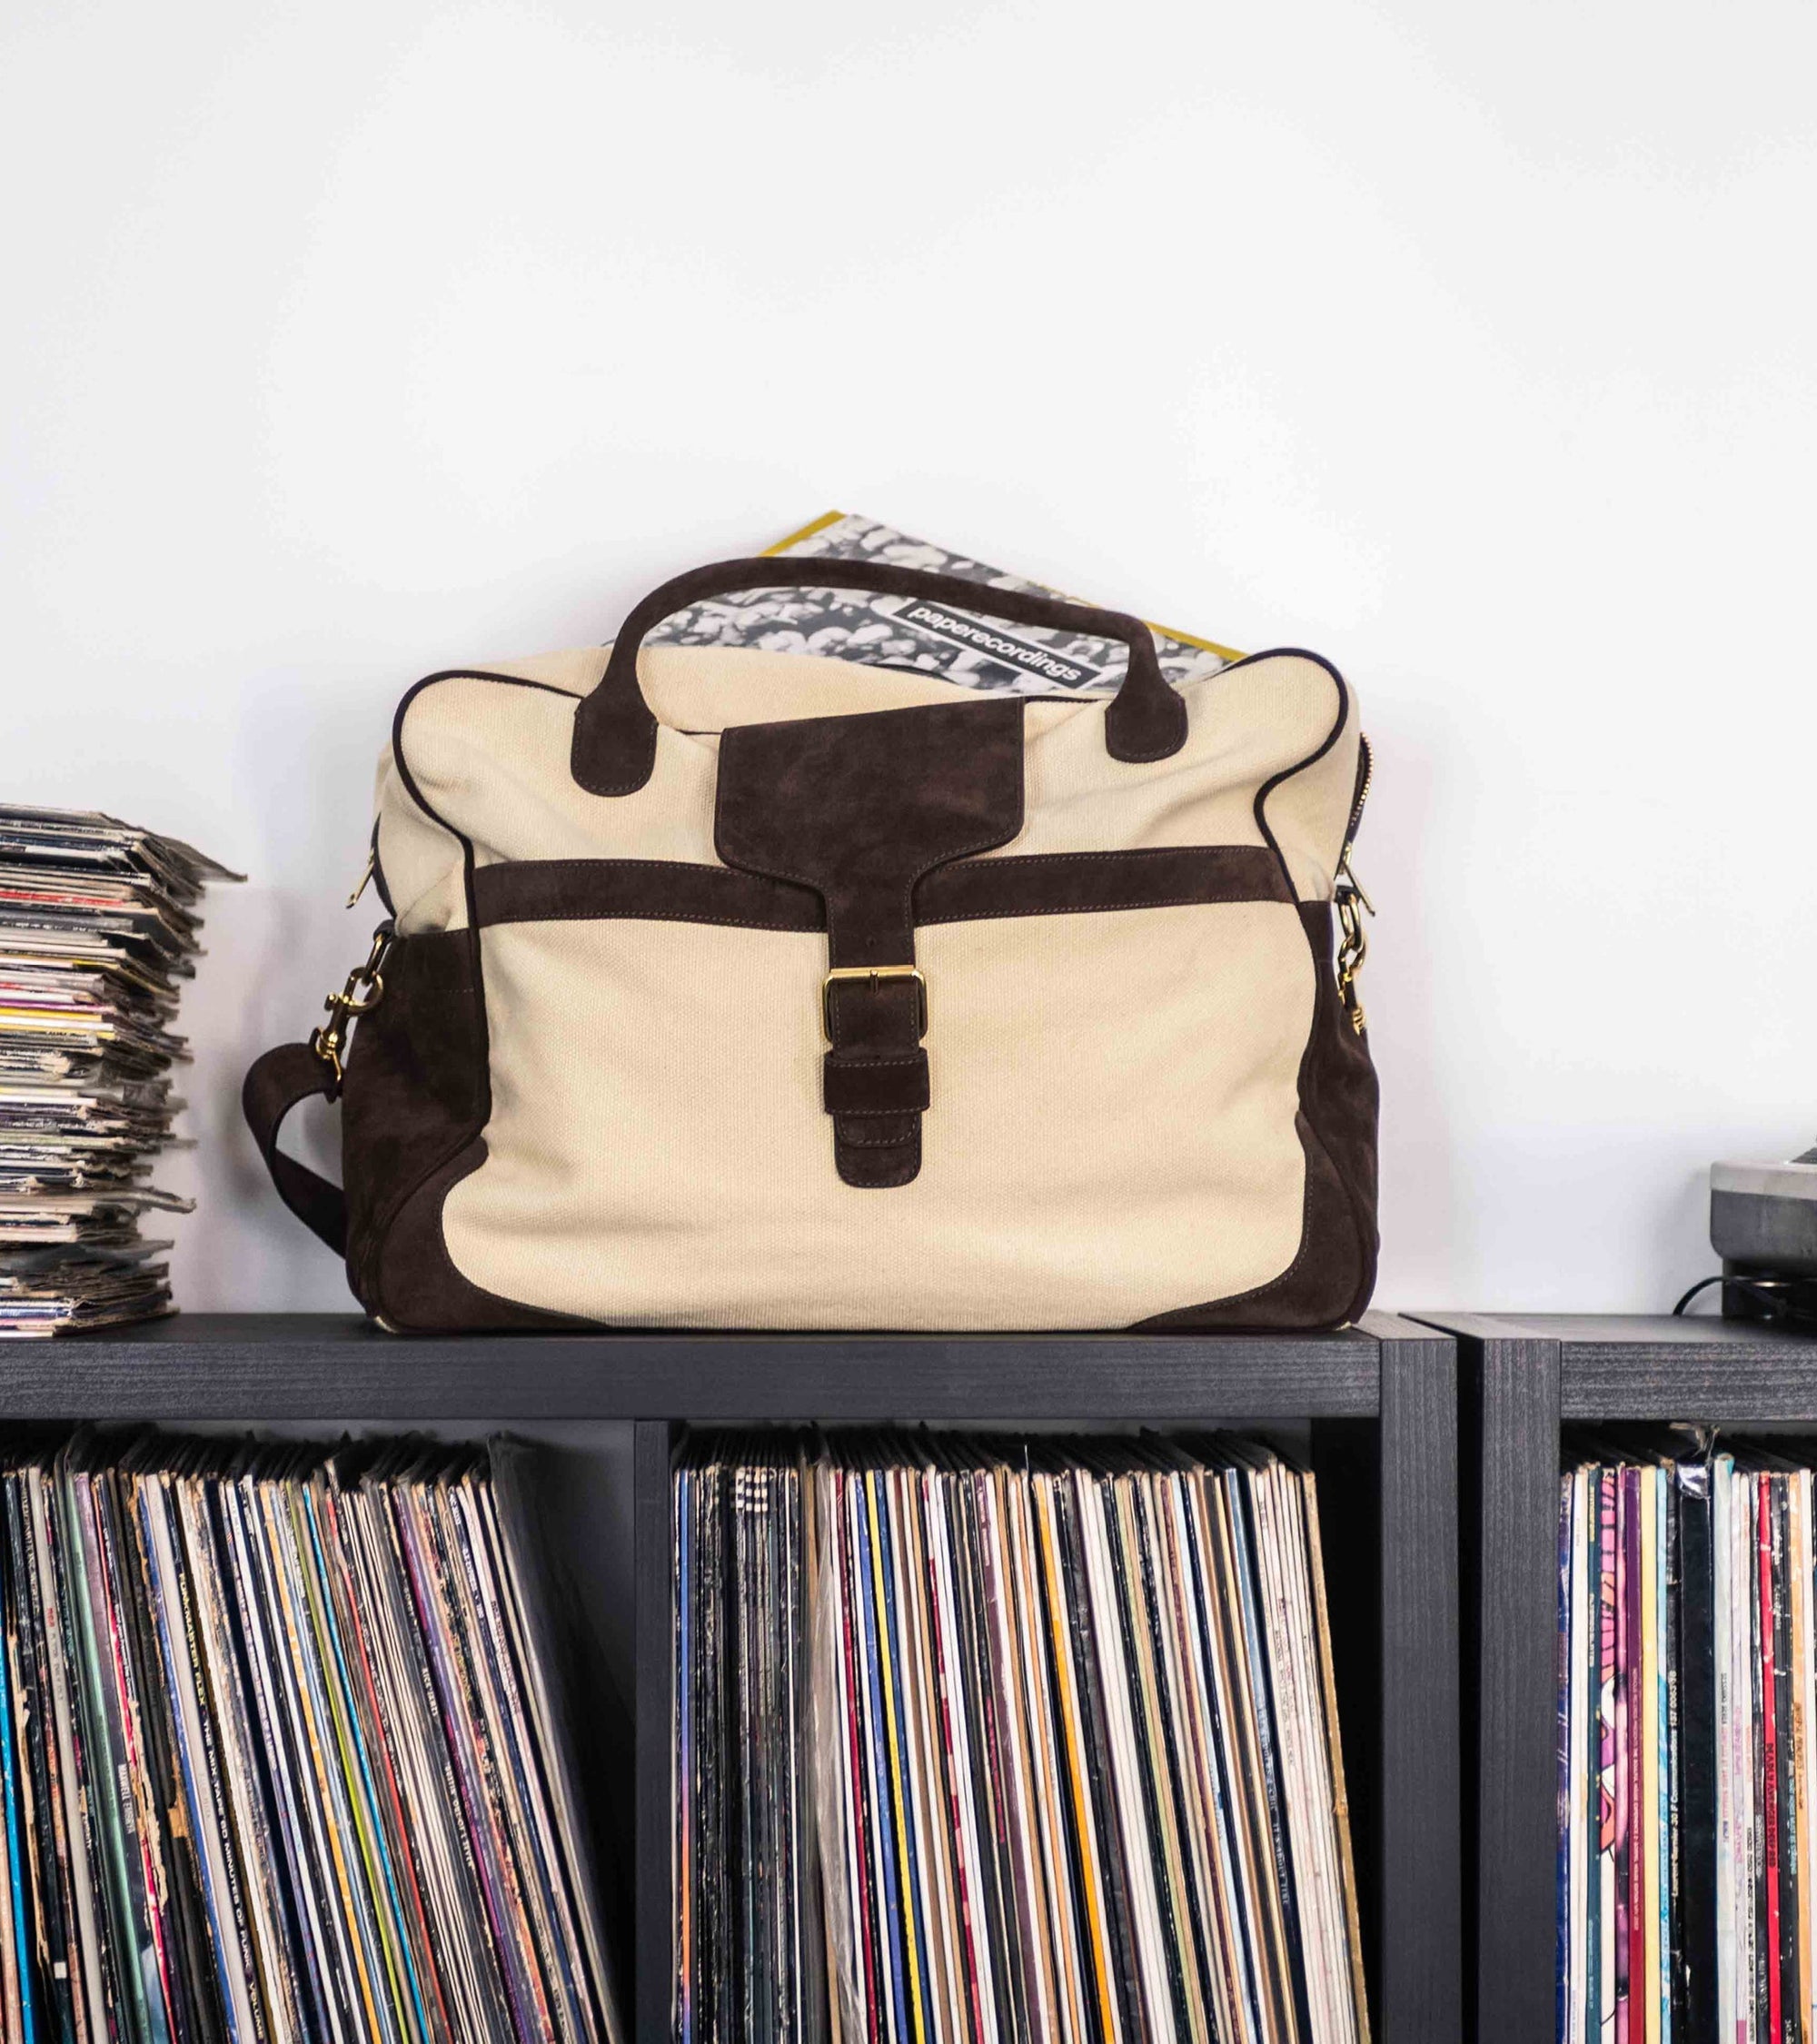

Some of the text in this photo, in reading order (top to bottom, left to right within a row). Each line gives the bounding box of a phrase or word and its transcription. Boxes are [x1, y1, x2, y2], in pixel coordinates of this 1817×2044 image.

[908, 606, 1081, 681] paperecordings
[118, 1763, 130, 1799] MAXWELL
[1670, 1729, 1678, 1802] Communications
[1765, 1742, 1773, 1781] DEADLY
[179, 1572, 198, 1668] FUNKMASTER
[195, 1672, 204, 1705] FLEX
[202, 1720, 213, 1746] THE
[208, 1751, 217, 1776] MIX
[213, 1781, 223, 1816] TAPE
[223, 1842, 240, 1904] MINUTES
[235, 1908, 243, 1927] OF
[239, 1930, 251, 1969] FUNK
[248, 1982, 263, 2039] VOLUME
[1767, 1783, 1775, 1826] AVENGER
